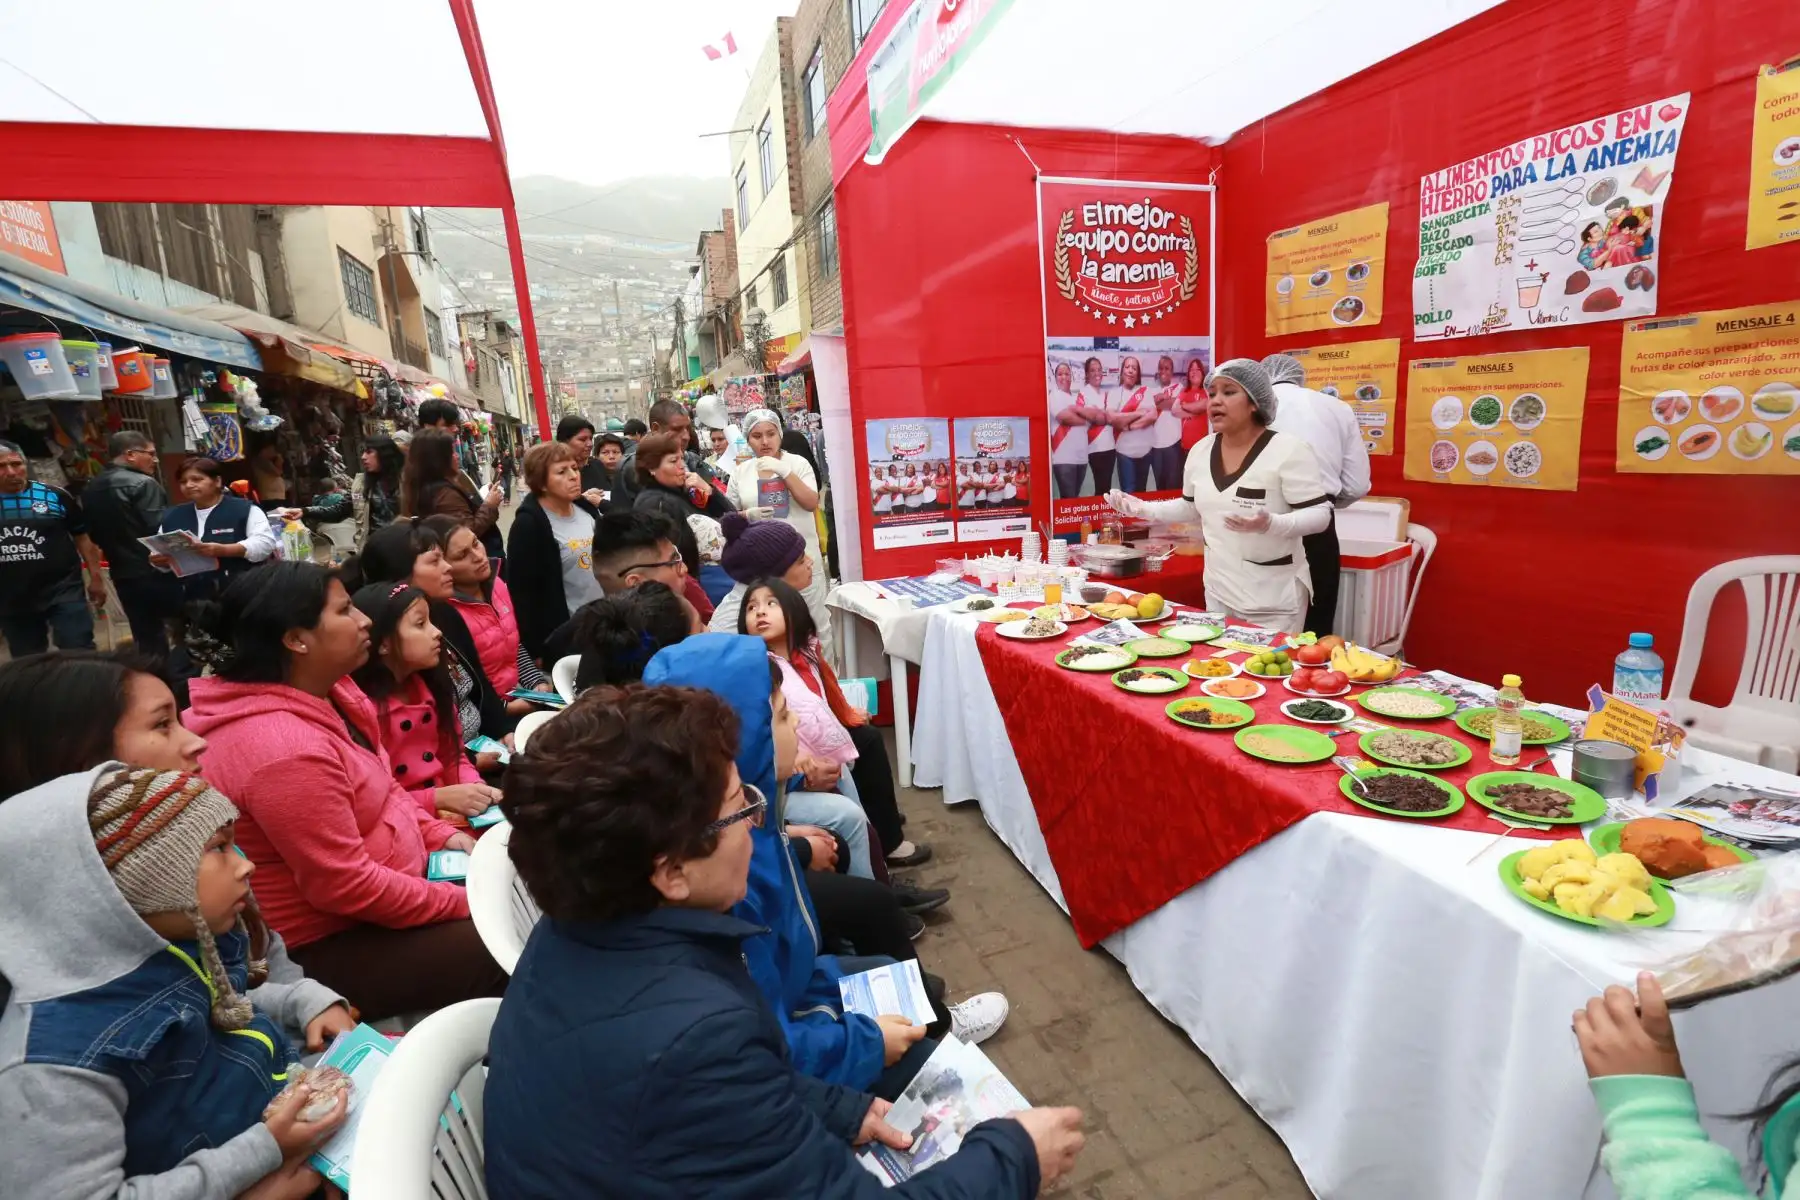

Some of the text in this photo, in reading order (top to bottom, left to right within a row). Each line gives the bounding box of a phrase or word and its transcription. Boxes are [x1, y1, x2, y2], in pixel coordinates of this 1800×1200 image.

[1763, 91, 1800, 110] Coma
[1421, 104, 1653, 197] ALIMENTOS RICOS EN
[1421, 128, 1677, 218] HIERRO PARA LA ANEMIA
[1082, 197, 1175, 231] El mejor
[1420, 202, 1492, 233] SANGRECITA
[1307, 225, 1334, 237] MENSAJE
[1420, 228, 1450, 245] BAZO
[1064, 228, 1191, 259] equipo contra
[1419, 235, 1474, 257] PESCADO
[1417, 250, 1462, 267] HIGADO
[1080, 255, 1176, 284] la anemia
[1415, 262, 1447, 278] BOFE
[1415, 309, 1453, 326] POLLO
[1560, 306, 1570, 322] C
[1716, 314, 1782, 333] MENSAJE
[1785, 312, 1796, 324] 4
[1443, 325, 1457, 338] EN
[1318, 350, 1345, 360] MENSAJE
[1636, 336, 1800, 361] Acompañe sus preparaciones
[1467, 363, 1506, 374] MENSAJE
[1508, 362, 1514, 371] 5
[1630, 362, 1660, 374] frutas
[1662, 361, 1675, 372] de
[1678, 359, 1706, 371] color
[1708, 352, 1776, 369] anaranjado,
[1699, 370, 1726, 381] color
[1729, 368, 1761, 379] verde
[1421, 384, 1445, 394] Incluya
[1494, 383, 1506, 391] sus
[1060, 505, 1072, 514] Las
[1072, 504, 1090, 514] gotas
[1091, 503, 1099, 511] de
[1093, 513, 1099, 521] el
[0, 552, 45, 562] MARTHA
[1, 543, 36, 554] ROSA
